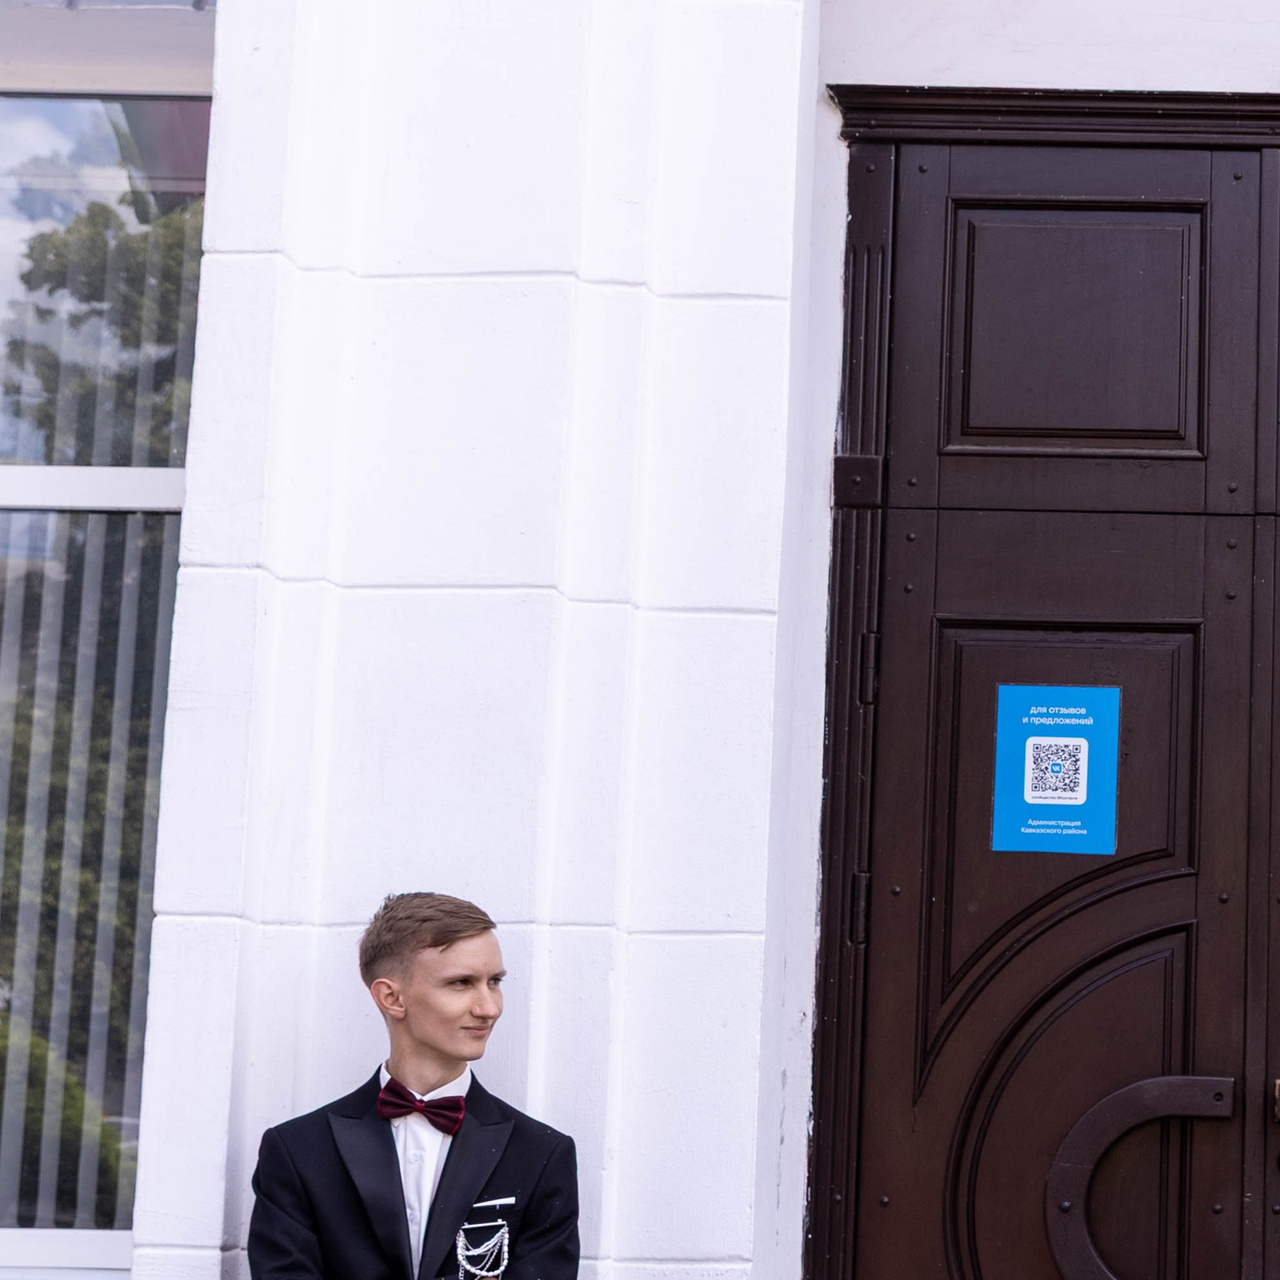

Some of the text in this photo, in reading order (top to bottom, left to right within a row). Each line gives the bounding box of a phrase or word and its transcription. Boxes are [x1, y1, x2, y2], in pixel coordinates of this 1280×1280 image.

[1030, 706, 1047, 714] для
[1030, 717, 1093, 725] предложений
[1027, 818, 1081, 827] Администрация
